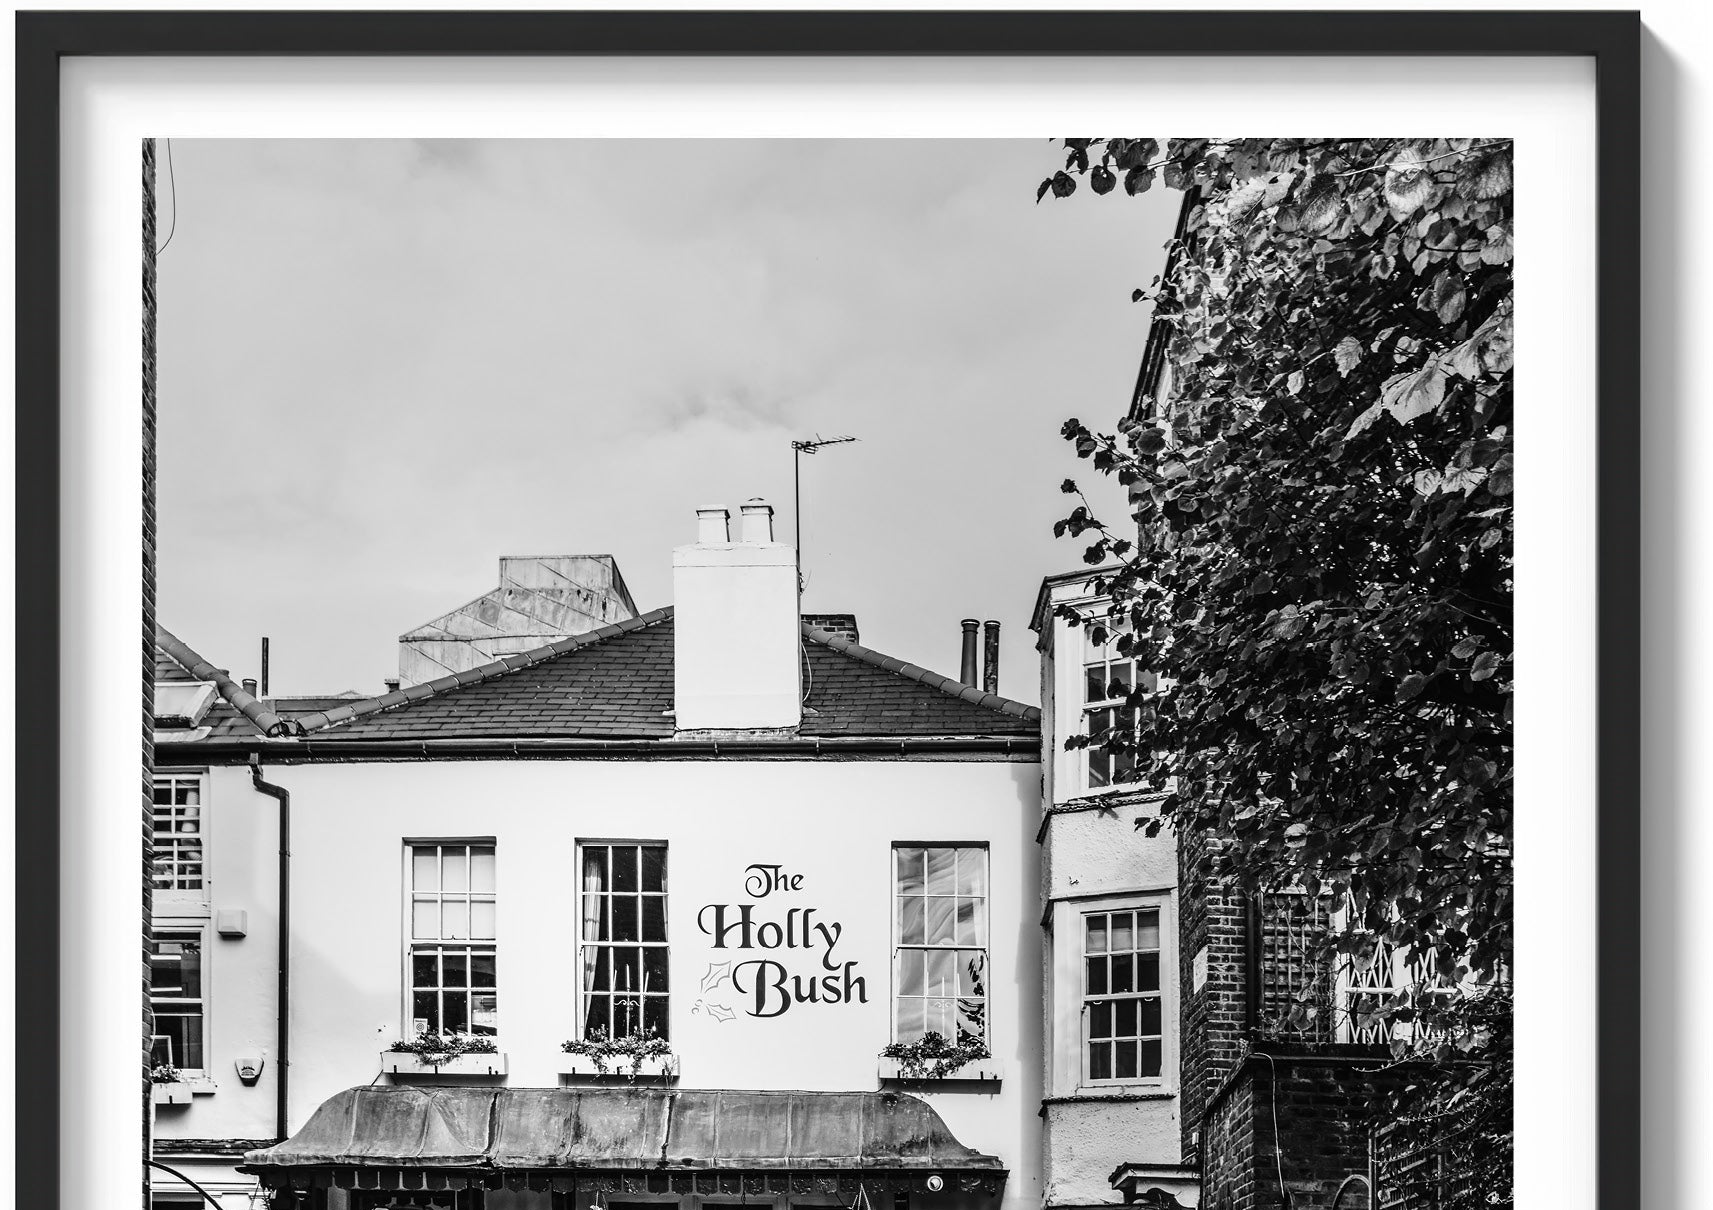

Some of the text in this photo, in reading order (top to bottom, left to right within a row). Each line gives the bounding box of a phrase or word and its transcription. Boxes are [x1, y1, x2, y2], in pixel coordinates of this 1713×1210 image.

[745, 864, 804, 898] The
[697, 904, 842, 971] Holly
[732, 959, 869, 1018] Bush
